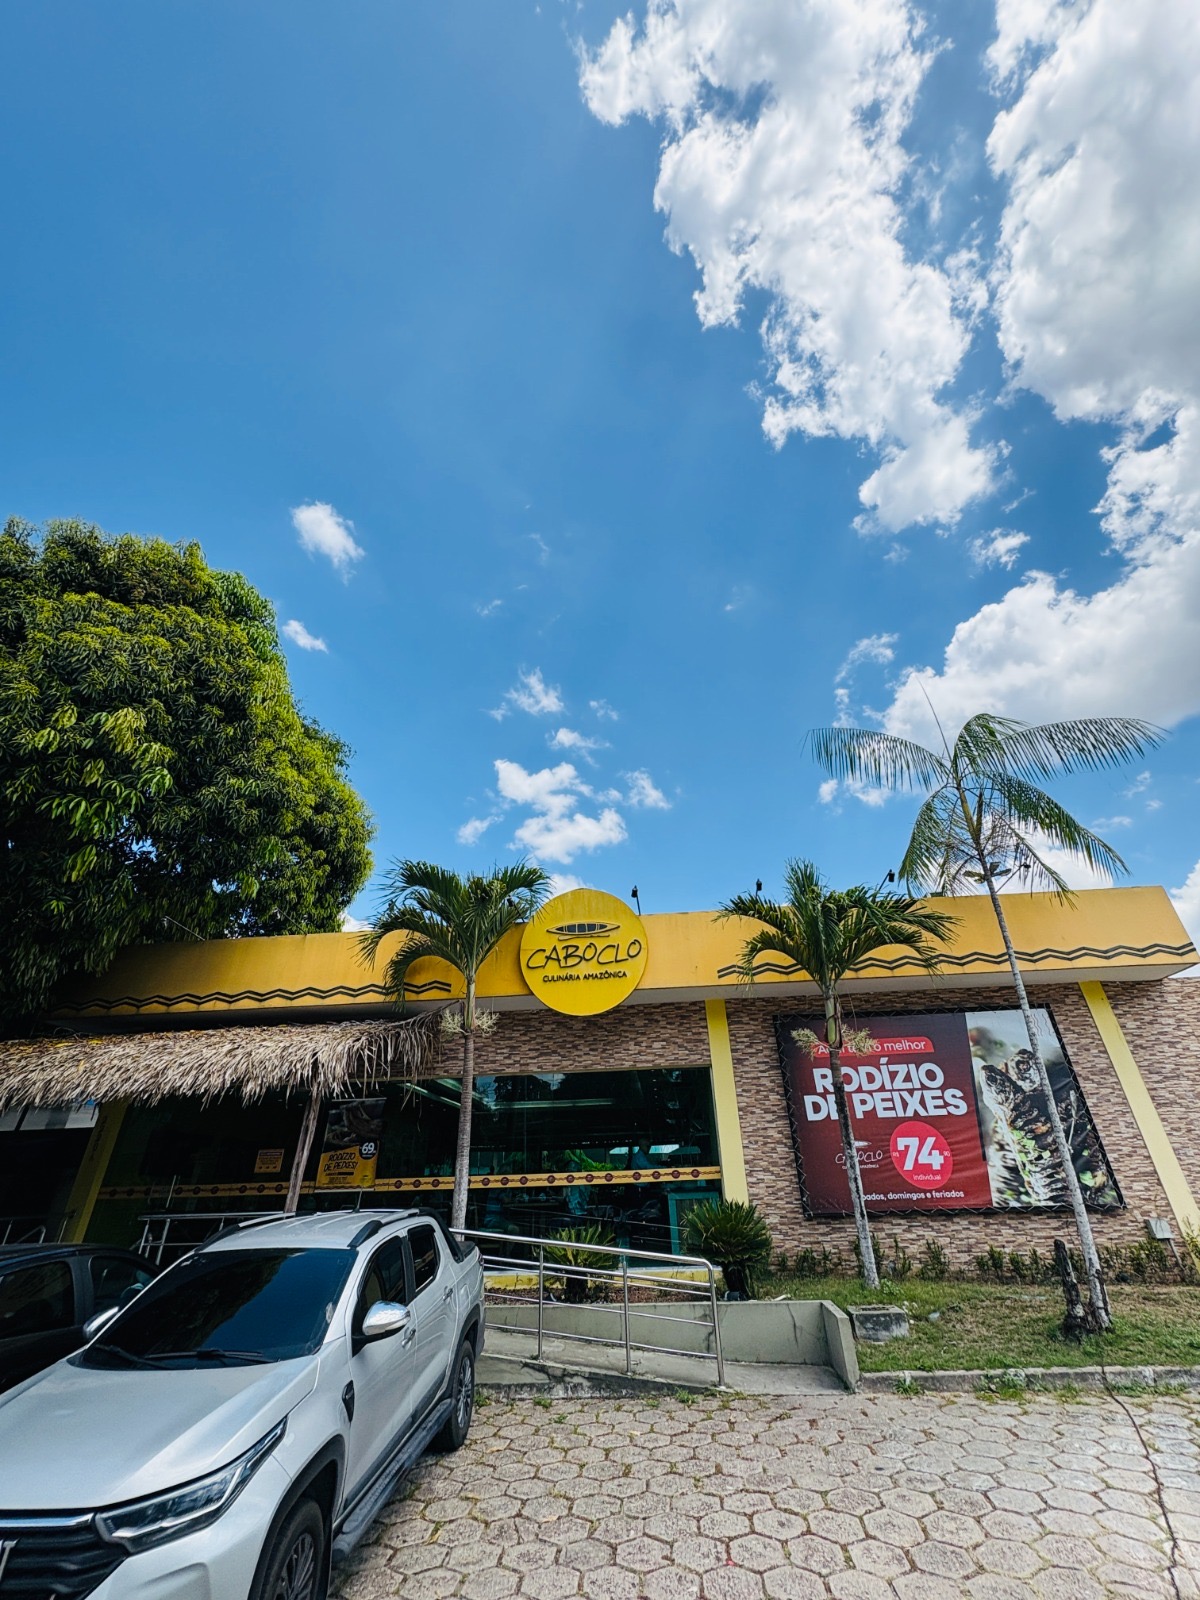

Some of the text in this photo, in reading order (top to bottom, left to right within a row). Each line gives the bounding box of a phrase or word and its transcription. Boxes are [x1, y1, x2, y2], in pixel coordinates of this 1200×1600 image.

[526, 939, 642, 969] CABOCLO
[542, 970, 627, 982] CULINÁRIA AMAZÔNICA
[884, 1040, 926, 1052] melhor
[812, 1058, 944, 1092] RODÍZIO
[852, 1088, 968, 1118] PEIXES
[835, 1150, 883, 1164] COCLO
[896, 1136, 945, 1171] 74
[887, 1191, 925, 1200] domingos
[932, 1190, 965, 1198] feriados
